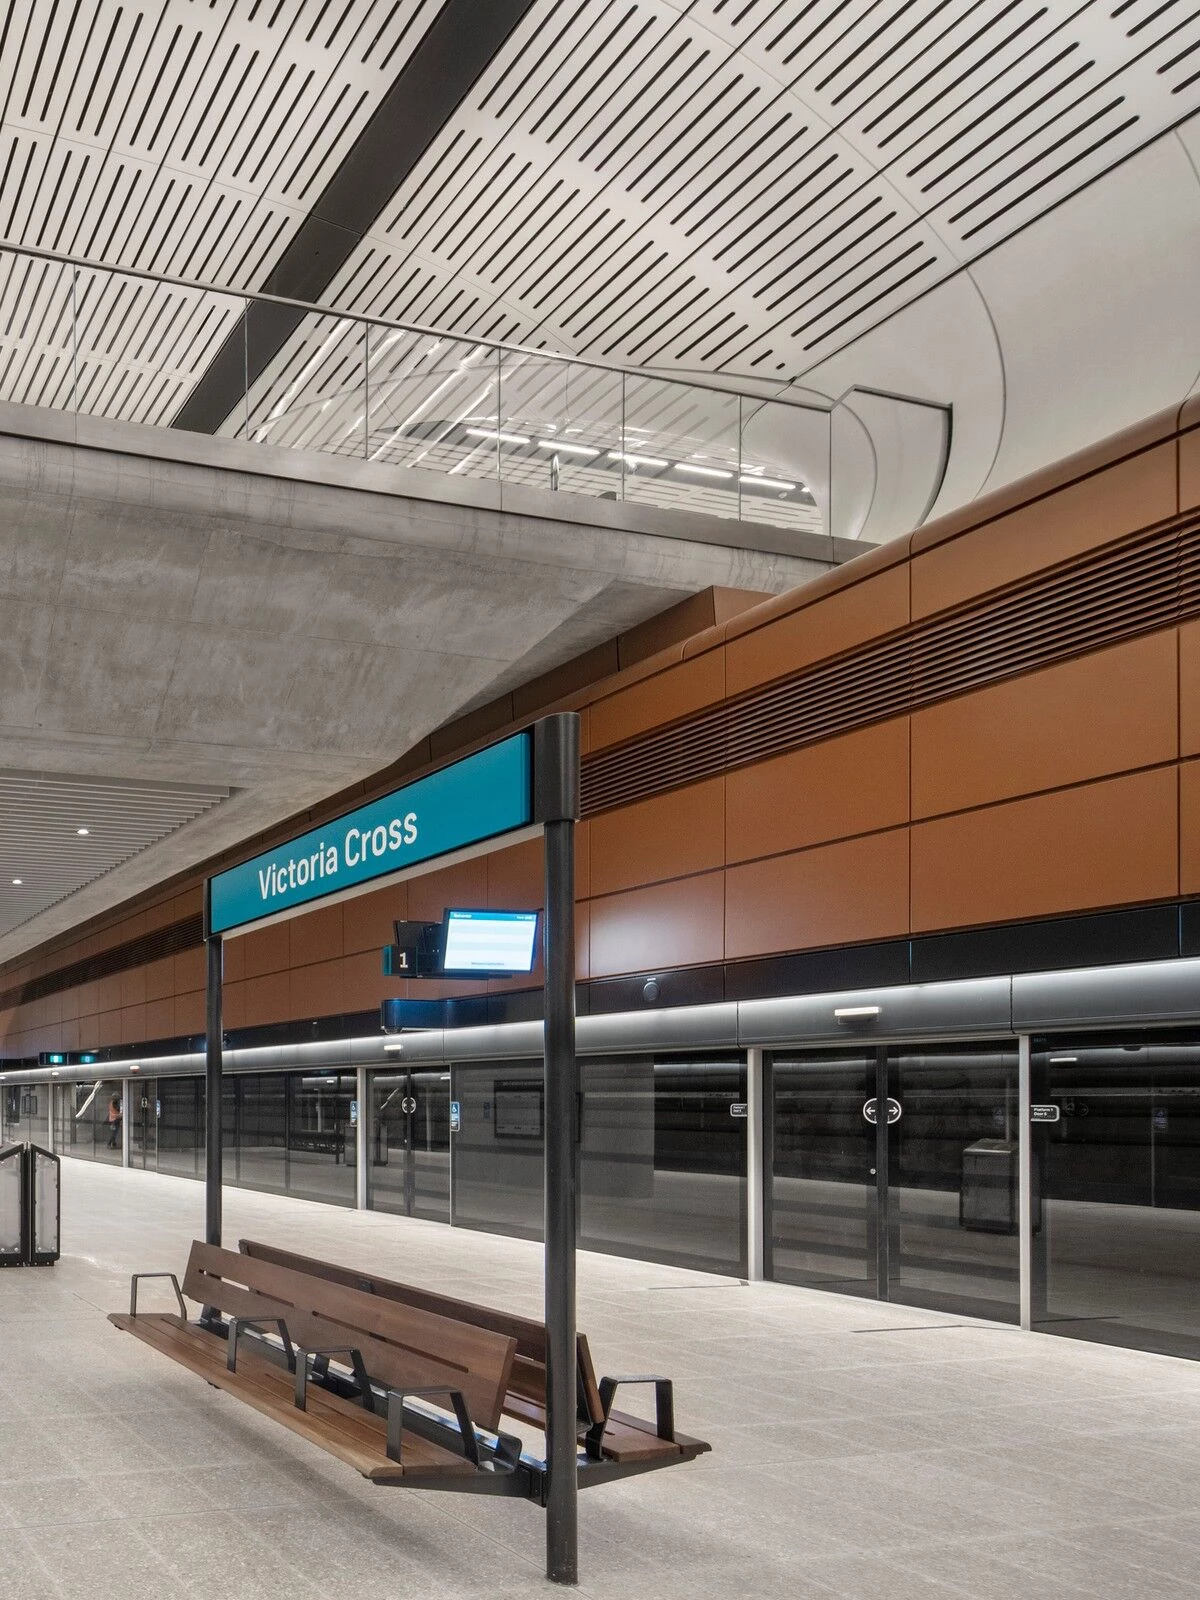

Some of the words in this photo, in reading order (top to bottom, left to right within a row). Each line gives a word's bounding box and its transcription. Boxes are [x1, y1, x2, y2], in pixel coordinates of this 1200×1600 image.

[258, 842, 338, 900] Victoria
[344, 812, 418, 867] Cross
[399, 952, 409, 969] 1
